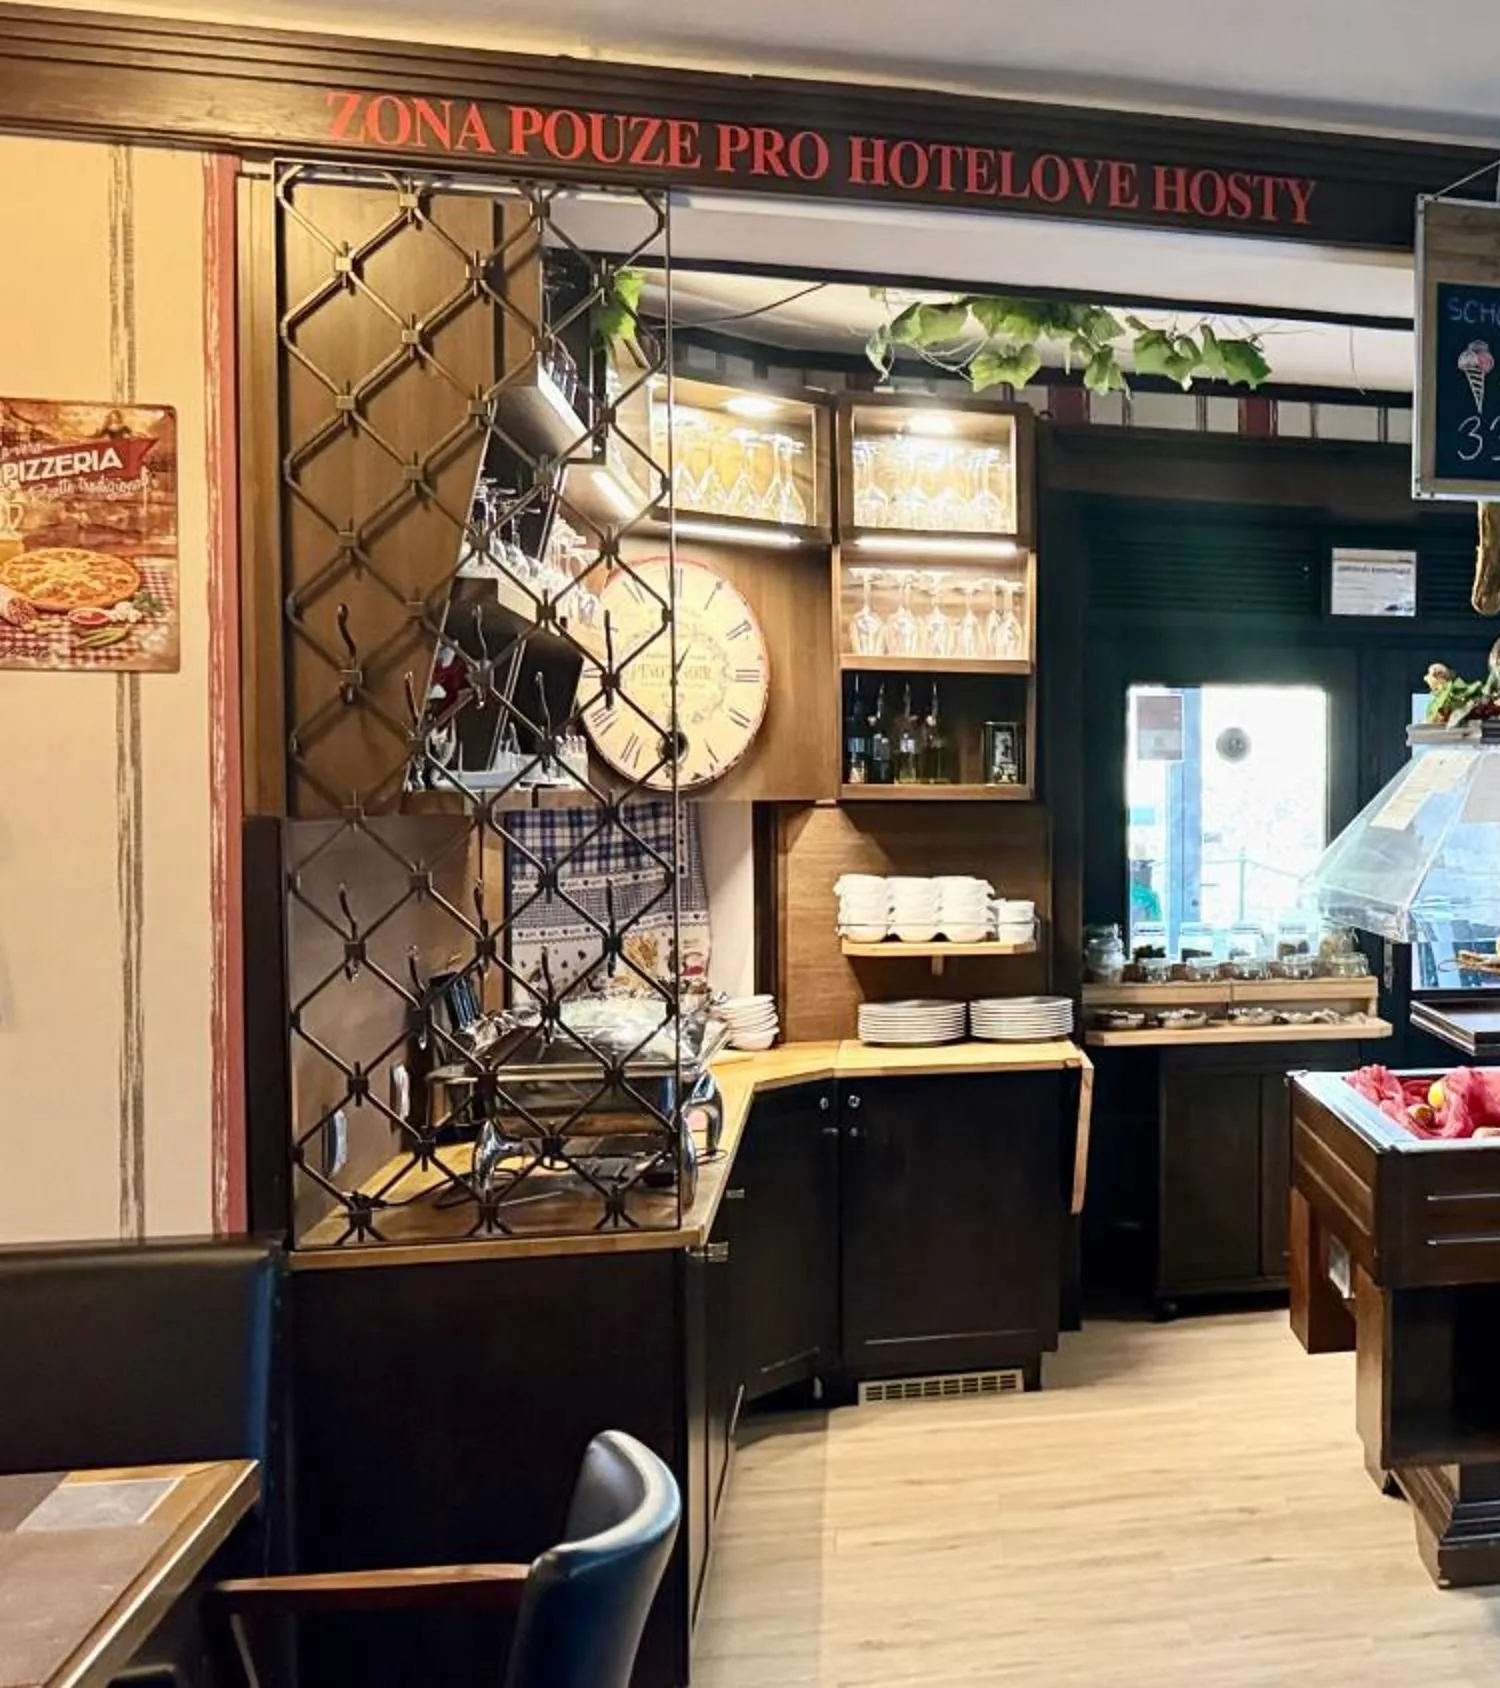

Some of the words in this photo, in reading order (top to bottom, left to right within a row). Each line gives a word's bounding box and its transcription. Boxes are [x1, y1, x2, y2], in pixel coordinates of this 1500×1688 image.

[325, 90, 496, 154] ZONA
[507, 104, 701, 170] POUZE
[716, 123, 830, 180] PRO
[848, 135, 1138, 208] HOTELOVE
[1152, 165, 1317, 225] HOSTY
[2, 448, 124, 485] PIZZERIA
